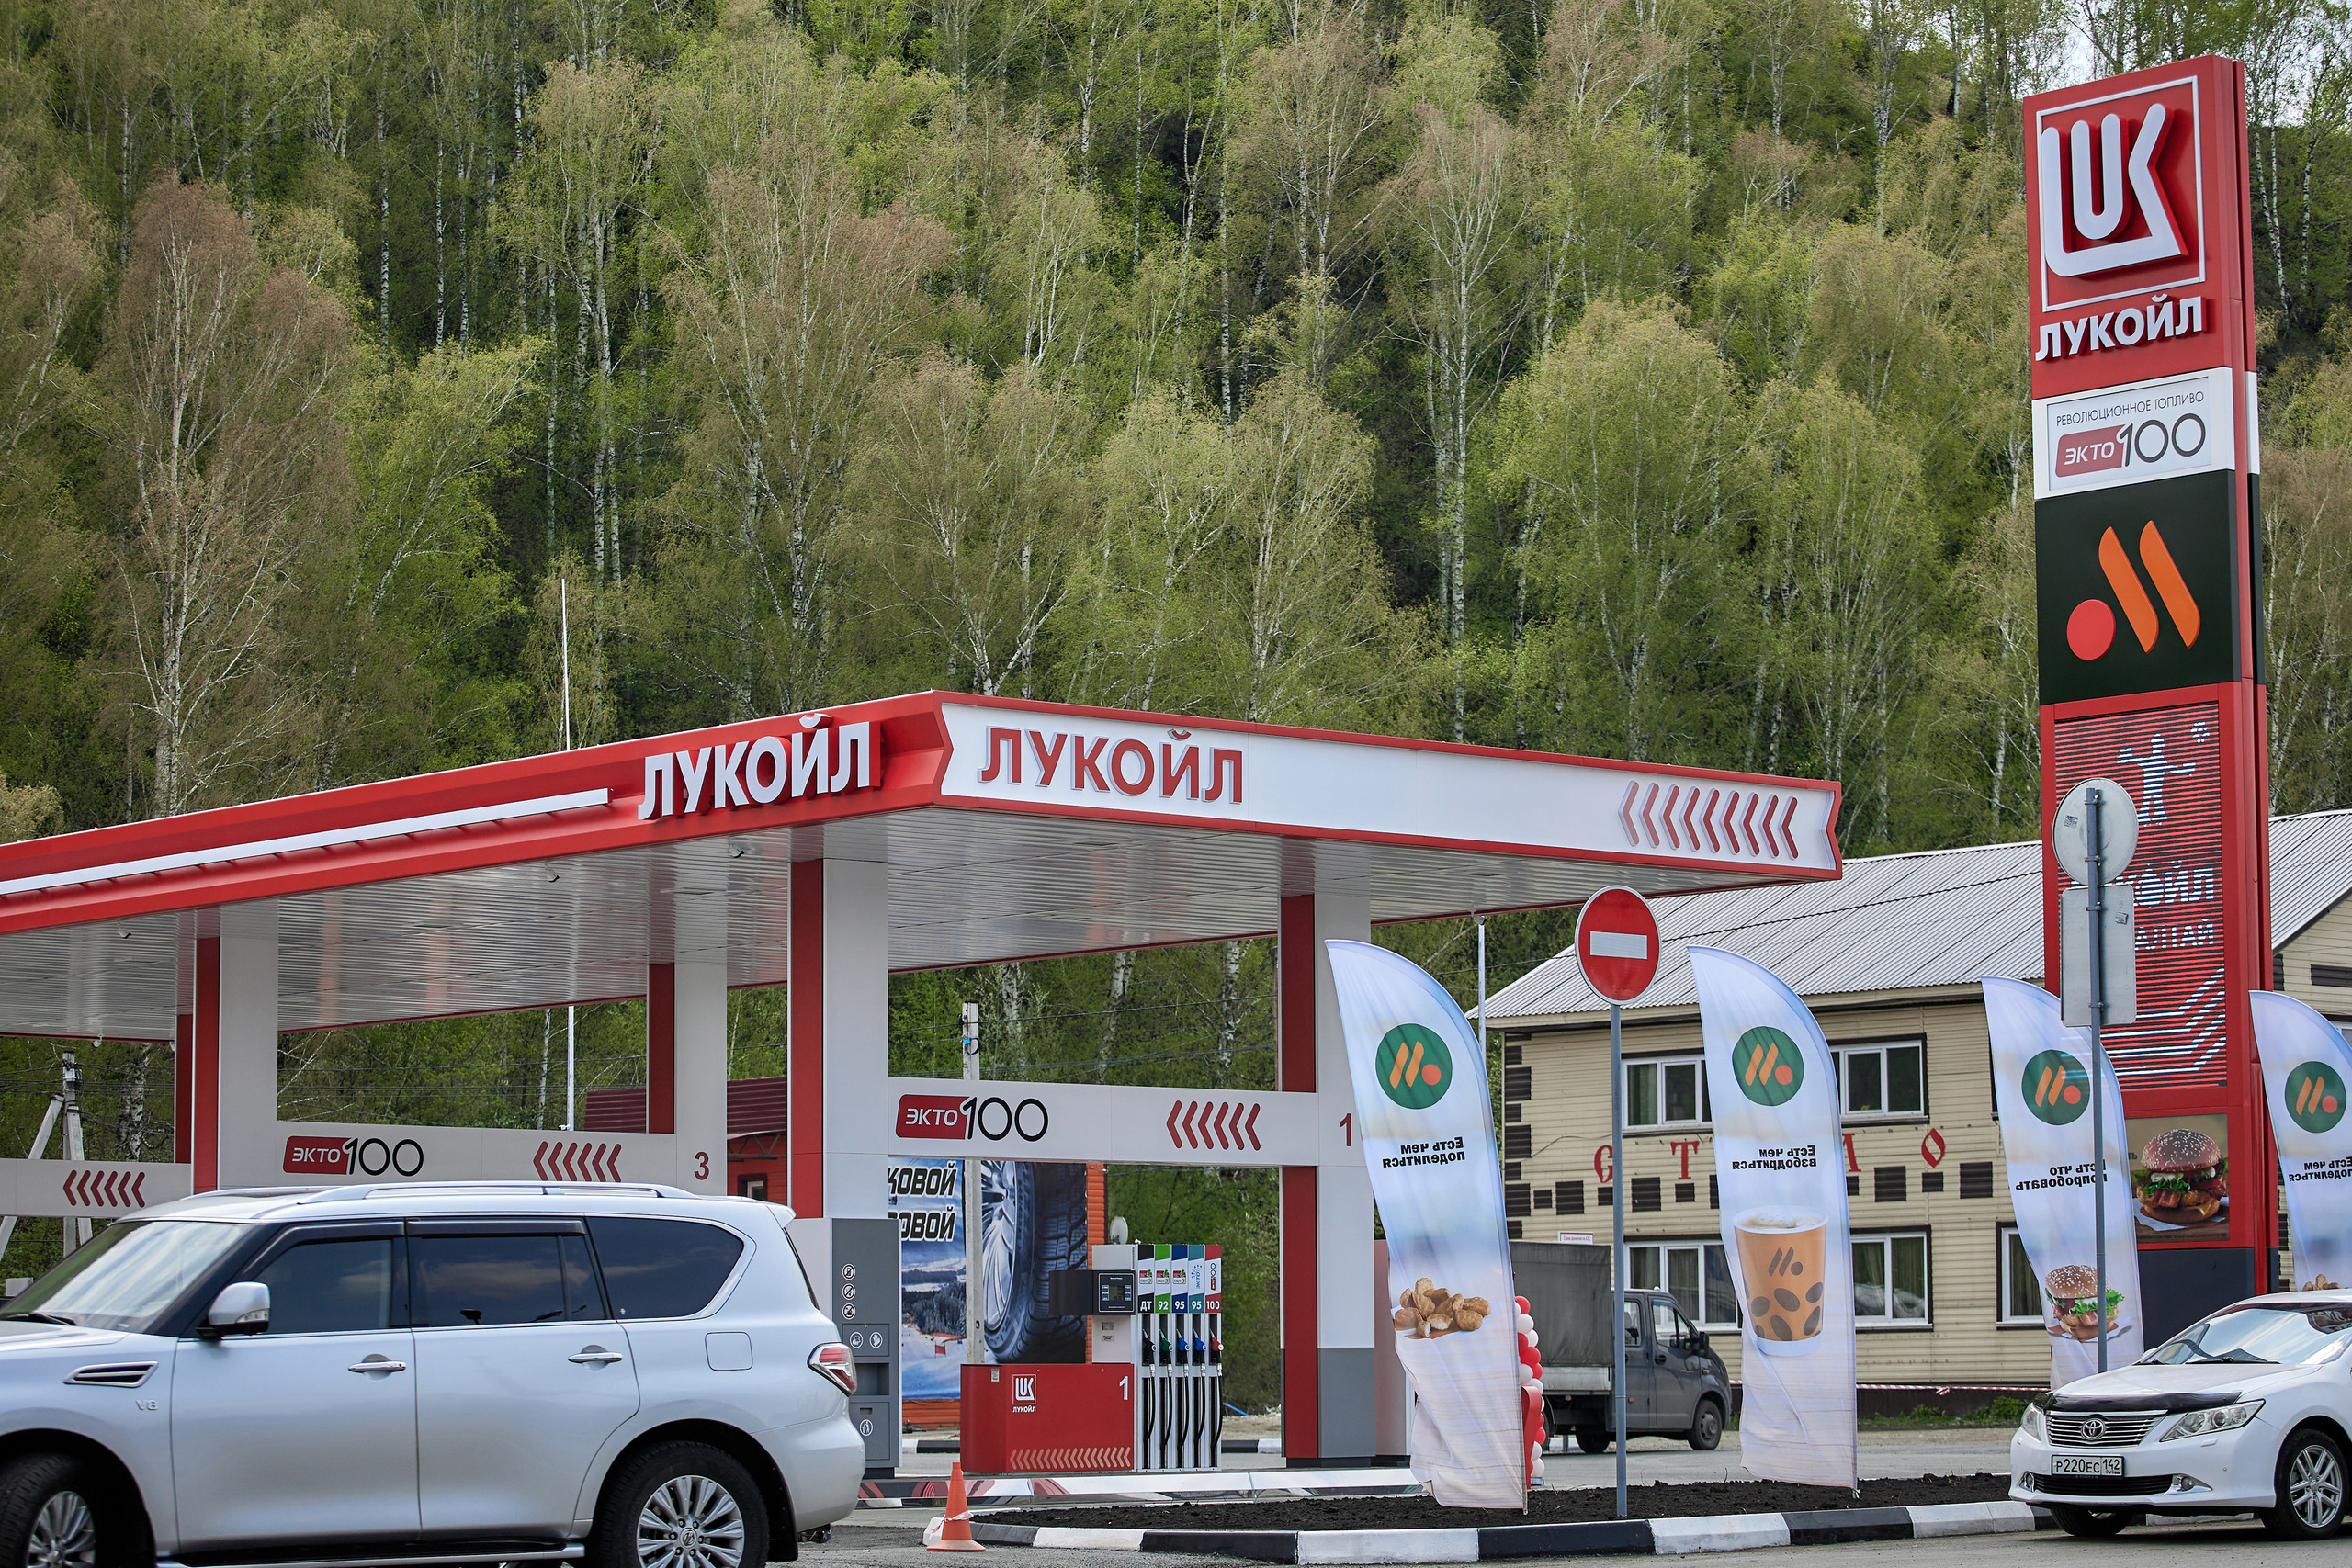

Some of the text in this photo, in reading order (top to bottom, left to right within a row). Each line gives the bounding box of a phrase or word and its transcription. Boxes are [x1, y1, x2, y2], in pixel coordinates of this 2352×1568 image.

[2036, 294, 2202, 361] ЛУКОЙЛ
[2056, 390, 2204, 426] РЕВОЛЮЦИОННОЕ ТОПЛИВО
[638, 713, 870, 820] ЛУКОЙЛ
[977, 728, 1243, 805] ЛУКОЙЛ
[1340, 1112, 1352, 1146] 1
[694, 1151, 709, 1180] 3
[888, 1206, 956, 1239] ОВОЙ
[1140, 1301, 1152, 1312] ДТ
[1158, 1301, 1169, 1311] 92
[1174, 1301, 1185, 1311] 95
[1192, 1301, 1202, 1311] 95
[1206, 1301, 1220, 1311] 100
[1119, 1375, 1129, 1401] 1
[135, 1399, 158, 1411] V8
